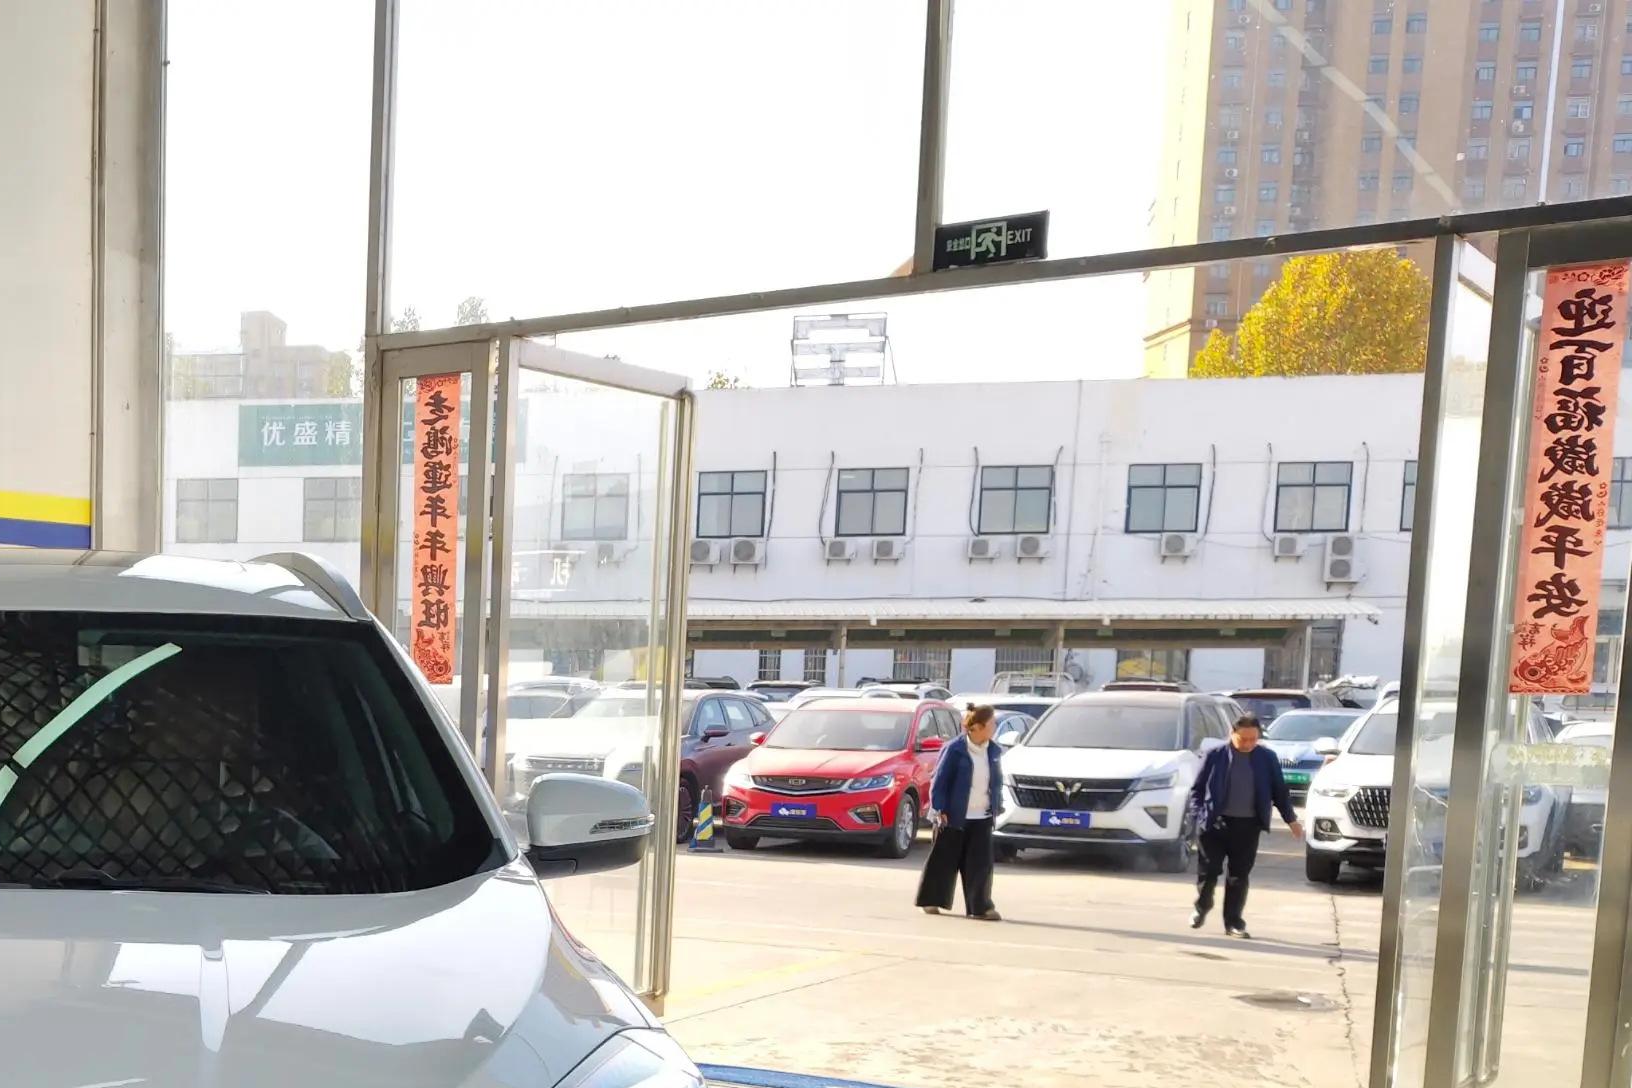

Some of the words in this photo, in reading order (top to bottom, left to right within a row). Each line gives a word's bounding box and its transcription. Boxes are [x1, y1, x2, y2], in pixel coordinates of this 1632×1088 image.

[1007, 228, 1033, 244] EXIT
[261, 421, 364, 447] 优盛精
